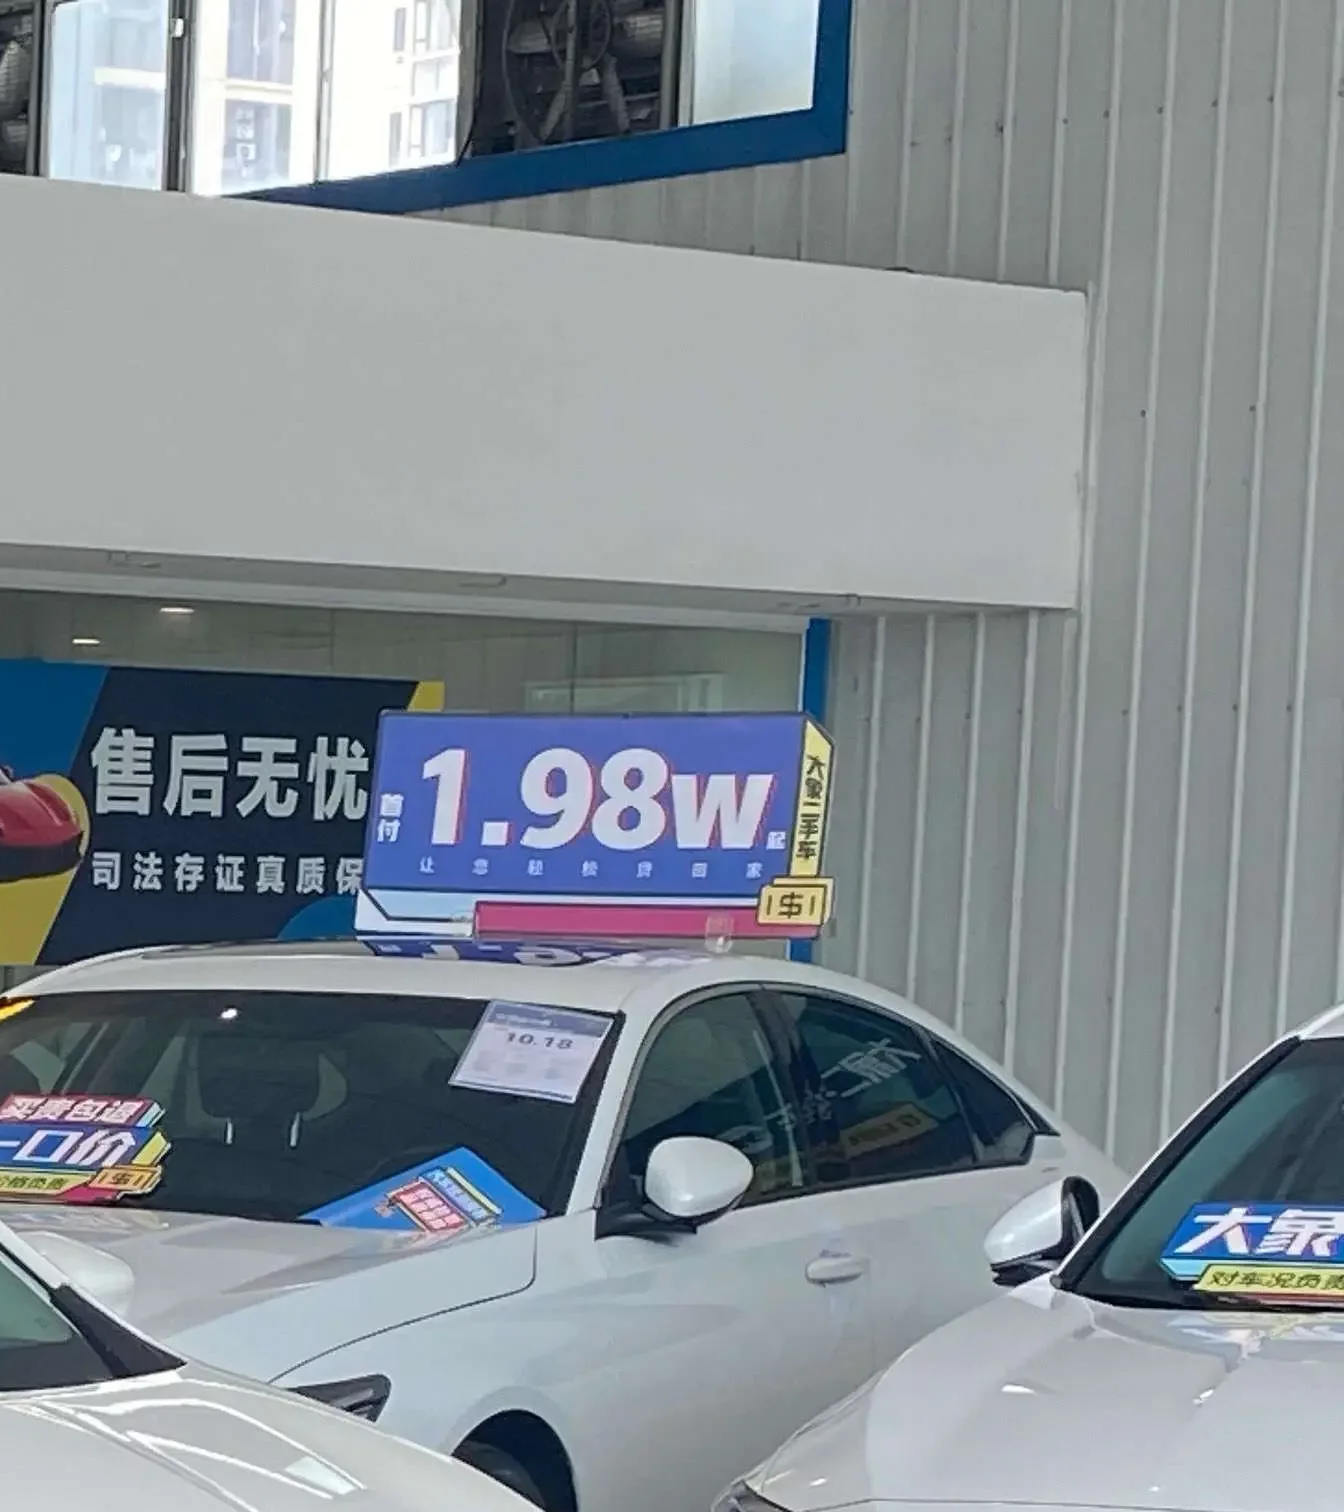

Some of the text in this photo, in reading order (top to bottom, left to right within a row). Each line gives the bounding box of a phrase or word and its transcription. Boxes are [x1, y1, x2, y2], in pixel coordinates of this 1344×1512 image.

[90, 727, 369, 821] 售后无忧
[422, 747, 776, 851] 1.98w
[91, 851, 364, 895] 司法存证真质保
[1173, 1207, 1344, 1257] 大象
